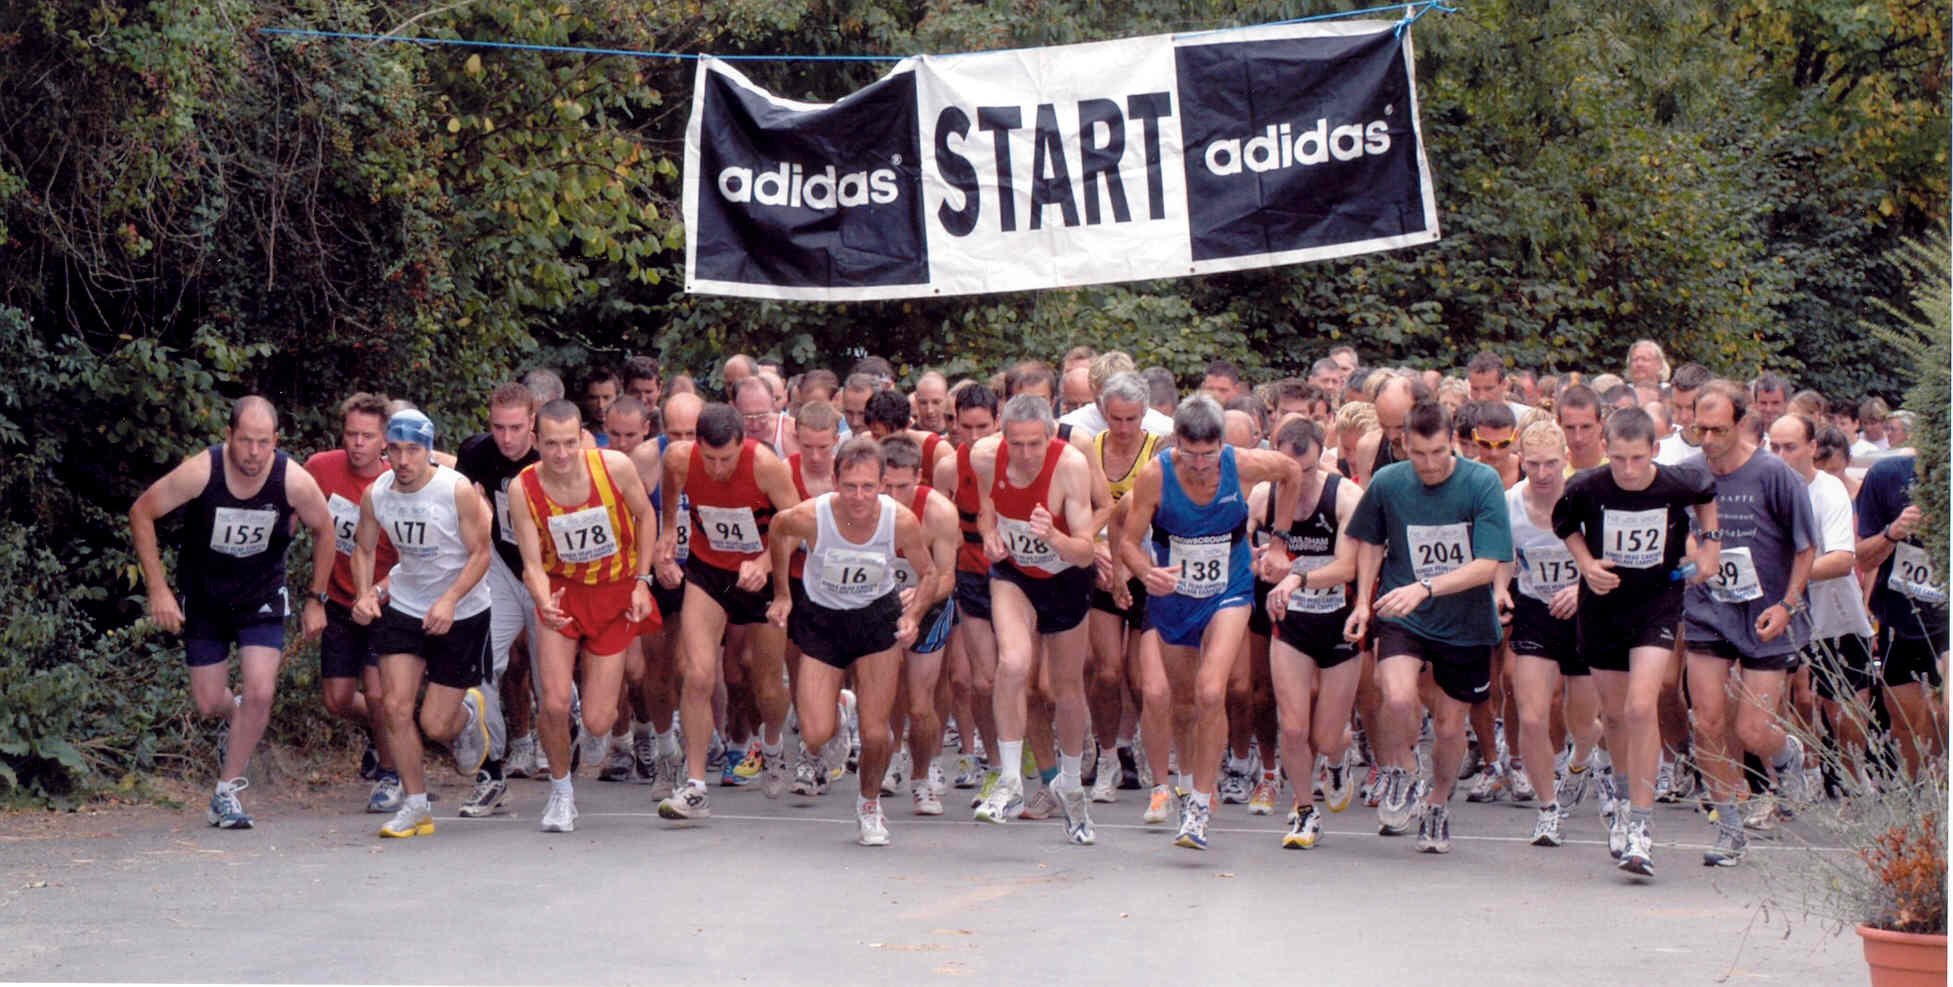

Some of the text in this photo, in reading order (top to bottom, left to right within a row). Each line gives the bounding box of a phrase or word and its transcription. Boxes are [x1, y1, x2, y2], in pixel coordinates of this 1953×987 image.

[1204, 118, 1392, 177] adidas
[935, 92, 1172, 237] START
[718, 162, 899, 210] adidas
[224, 525, 265, 545] 155
[334, 515, 358, 543] 15
[394, 521, 426, 544] 177
[564, 525, 607, 550] 178
[716, 522, 743, 541] 94
[1616, 528, 1658, 552] 152
[1009, 531, 1049, 554] 128
[1419, 542, 1464, 566] 204
[842, 567, 867, 584] 16
[1181, 559, 1221, 581] 138
[1539, 560, 1578, 583] 175
[1902, 560, 1942, 588] 20
